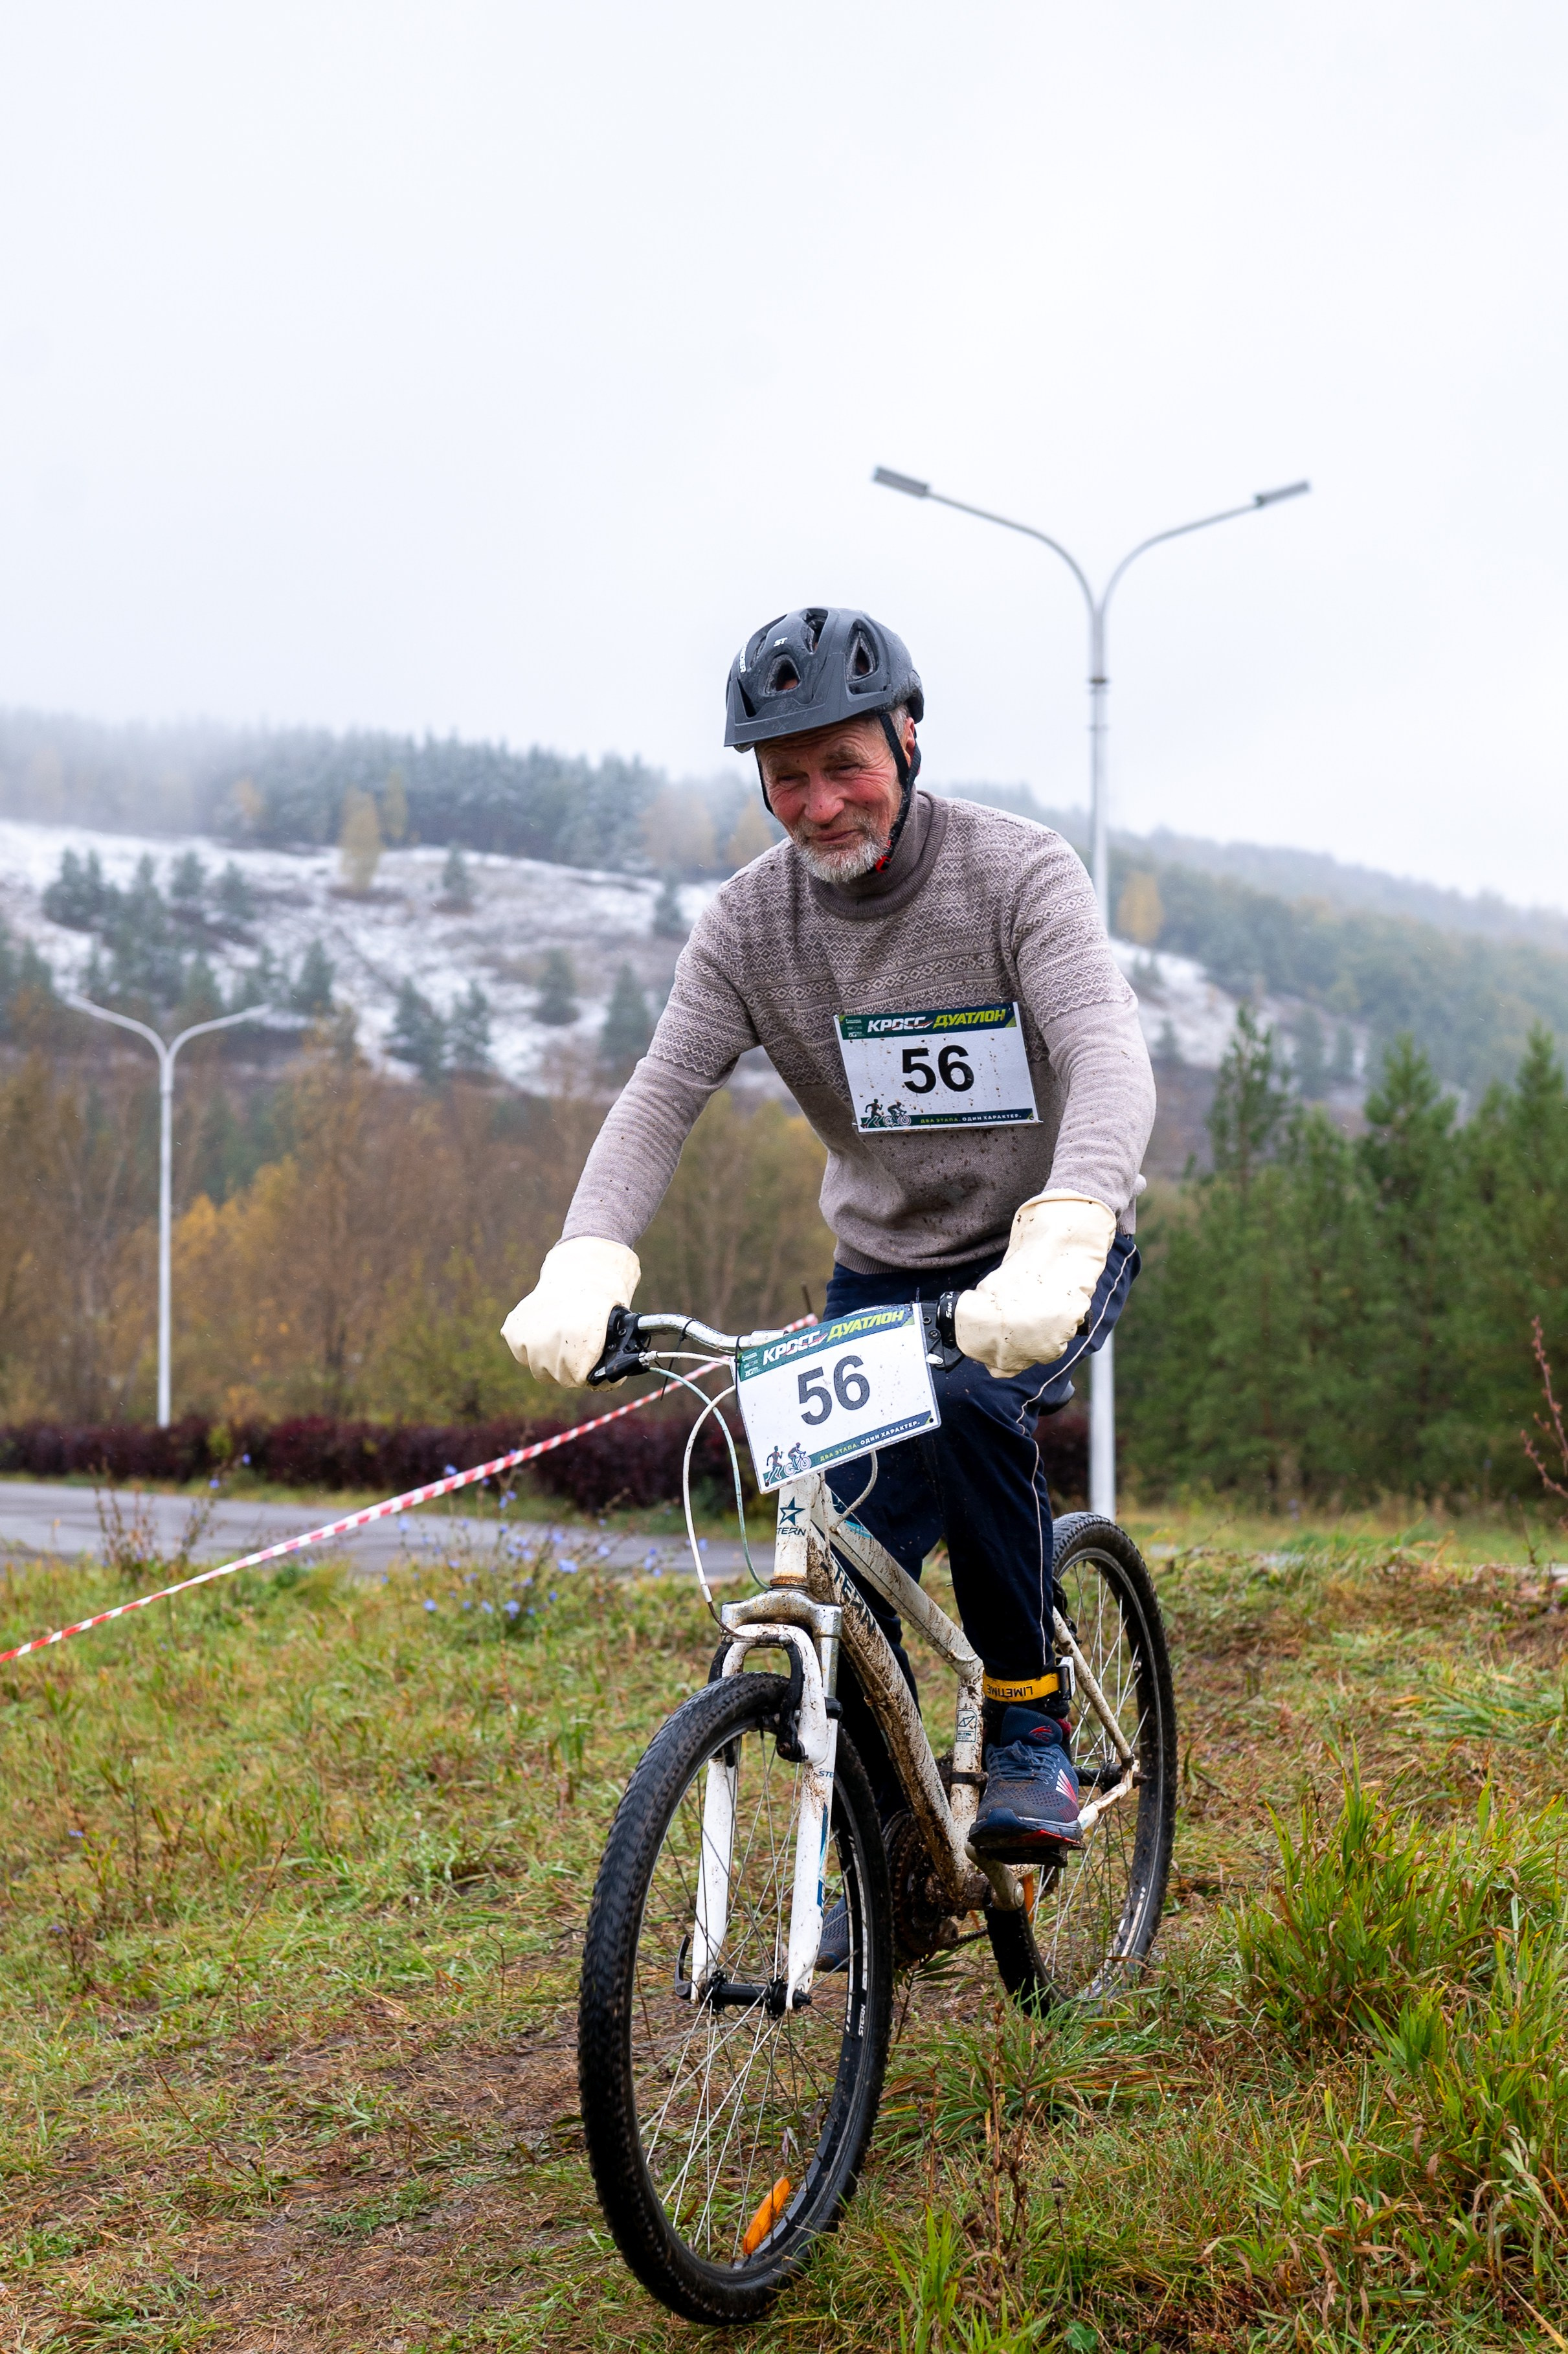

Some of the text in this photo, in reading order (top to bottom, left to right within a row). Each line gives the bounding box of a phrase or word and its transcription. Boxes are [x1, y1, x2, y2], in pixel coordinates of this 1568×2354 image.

[868, 1009, 1006, 1033] КРОСС ДУАТЛОН
[902, 1044, 974, 1093] 56
[763, 1310, 904, 1365] КРОСС ДУАТЛОН
[798, 1355, 870, 1425] 56
[820, 1452, 834, 1461] ДВА
[860, 1434, 880, 1445] ОДИН
[880, 1420, 921, 1438] ХАРАКТЕР.
[776, 1527, 807, 1536] TERN
[987, 1685, 1033, 1698] LIMETIME
